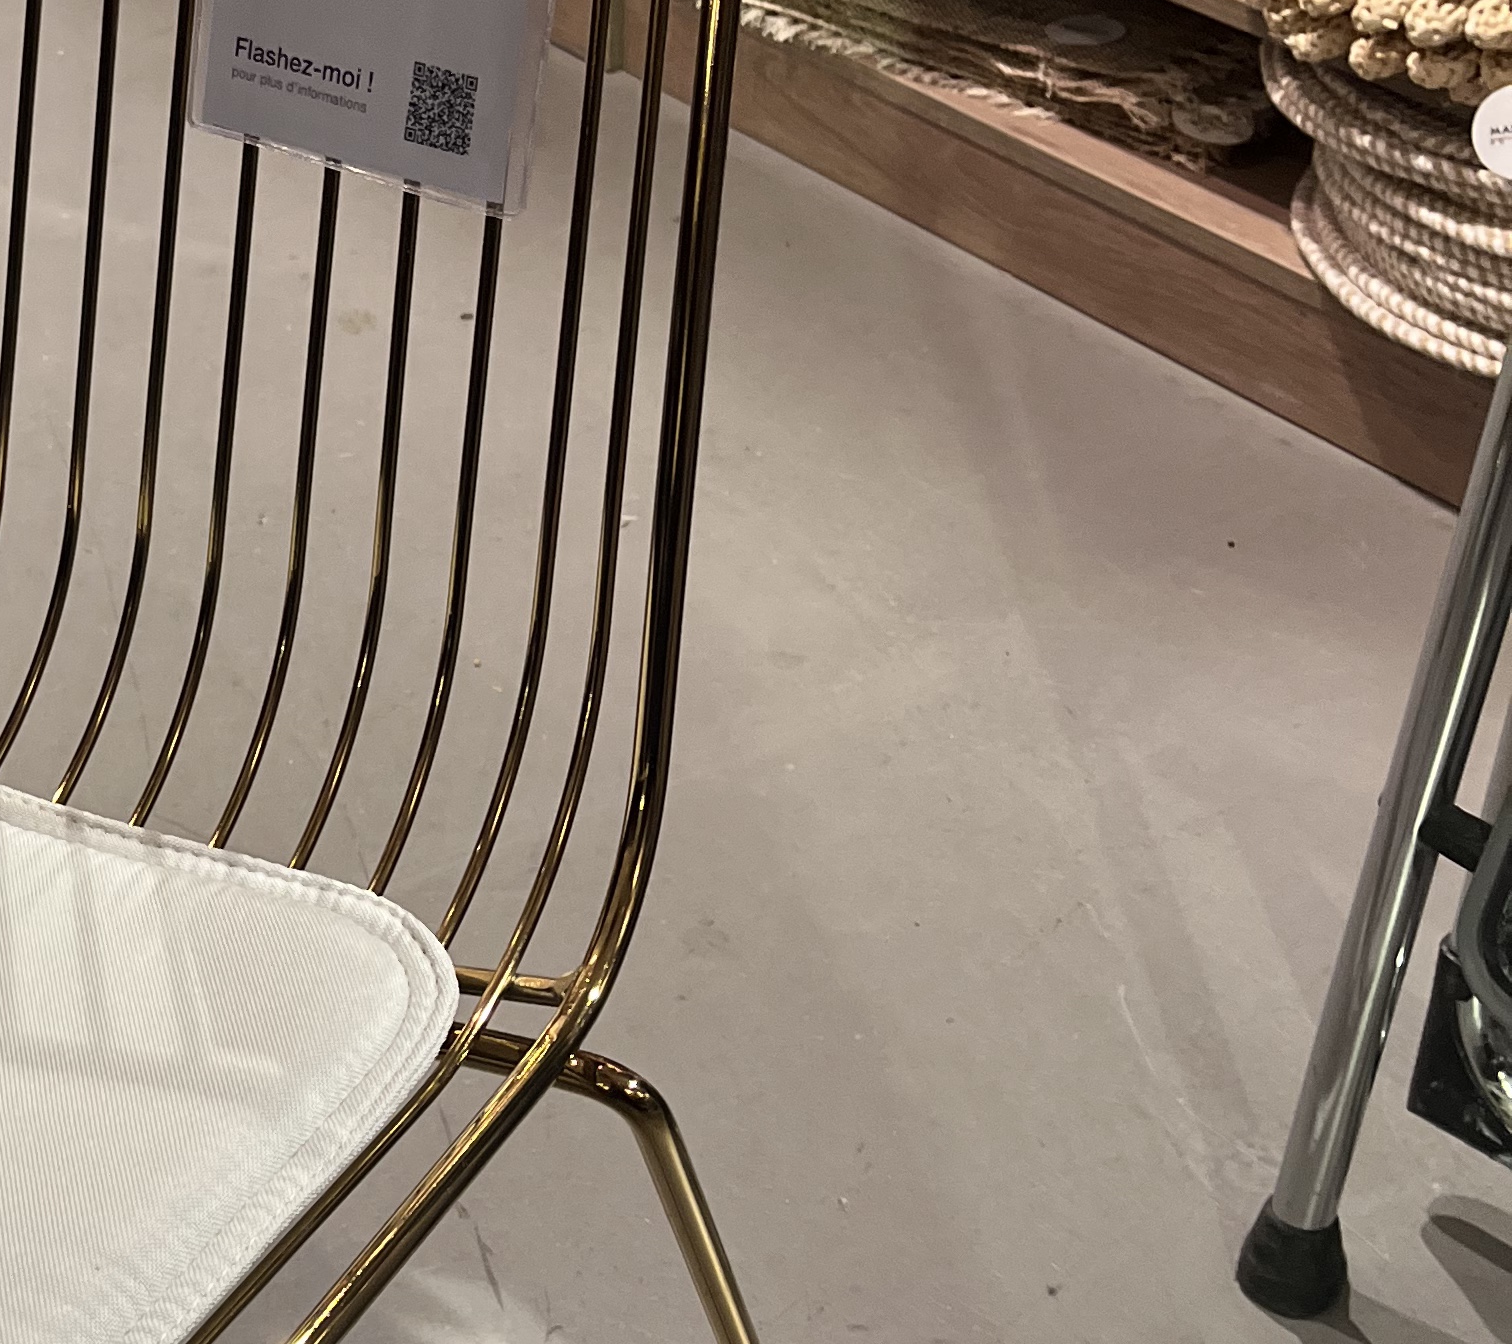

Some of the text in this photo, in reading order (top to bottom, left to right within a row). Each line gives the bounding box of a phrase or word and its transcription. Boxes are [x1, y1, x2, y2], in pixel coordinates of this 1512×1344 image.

[235, 36, 362, 90] Flashez-moi
[231, 67, 367, 114] pour plus d'informations
